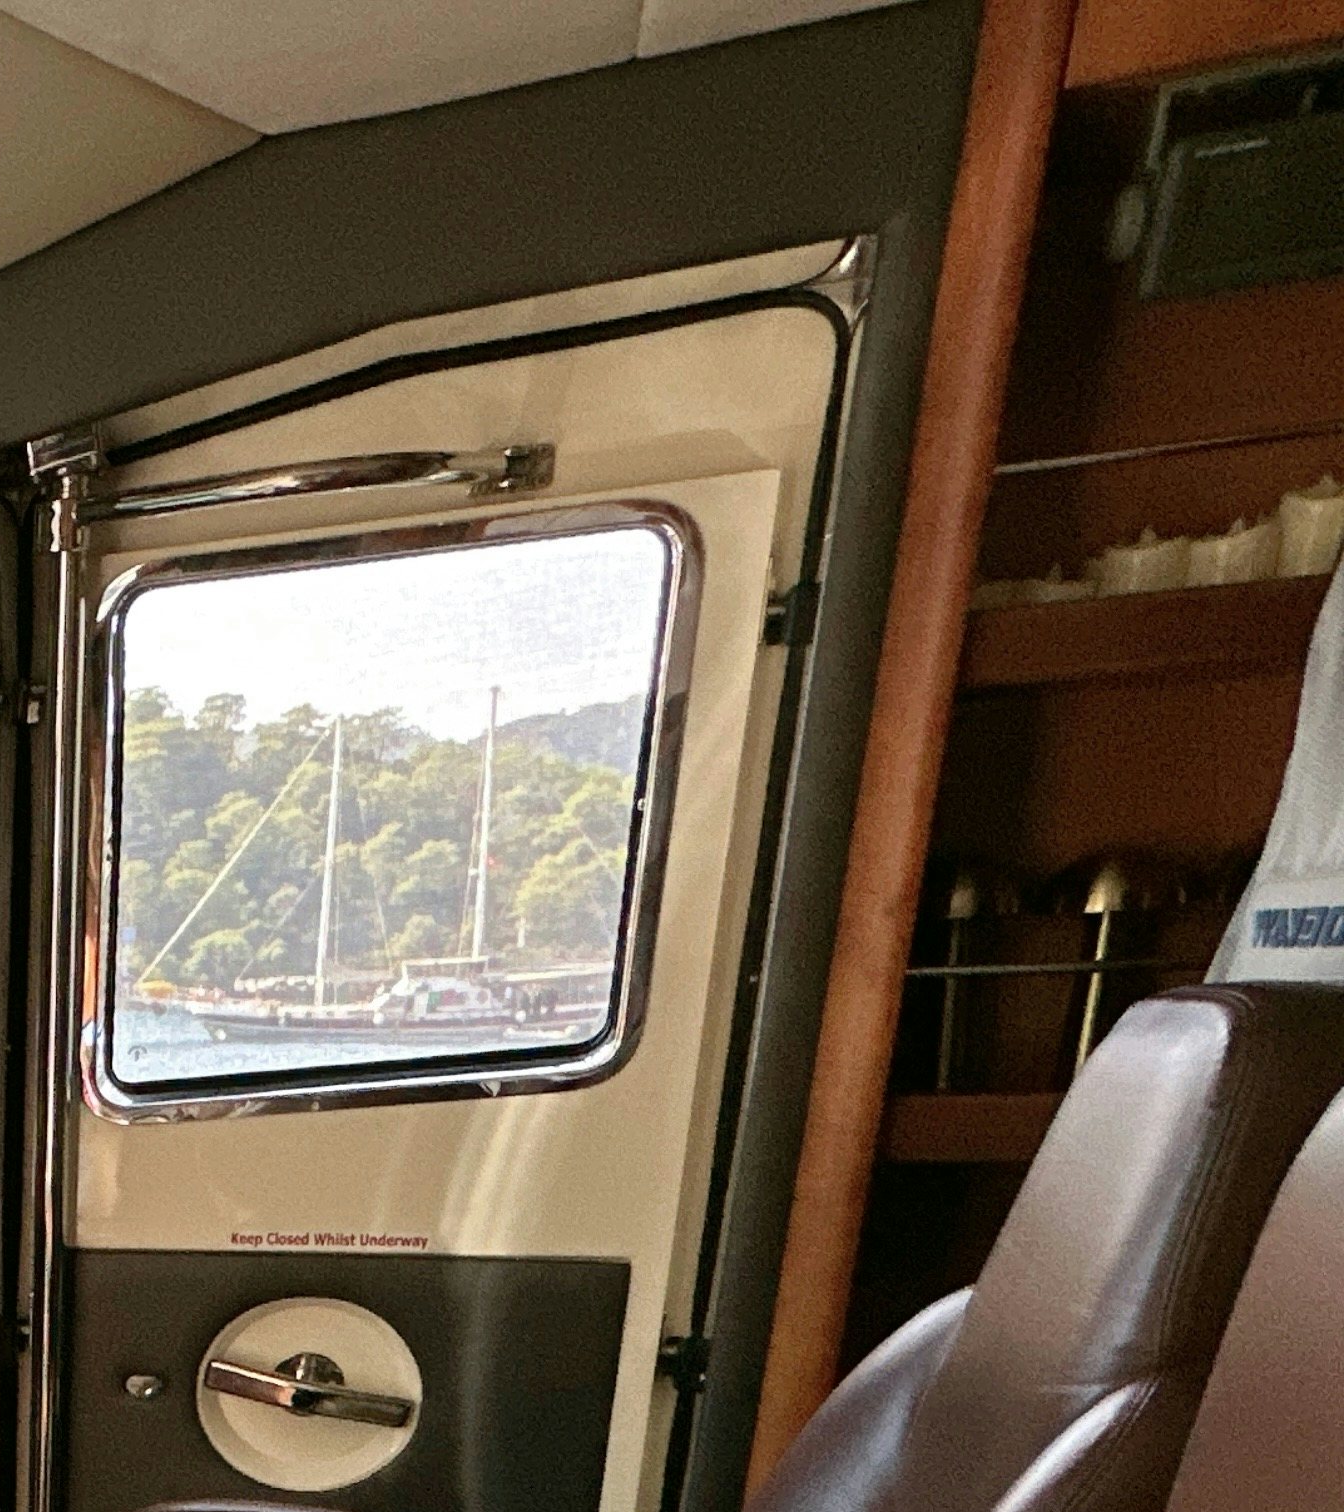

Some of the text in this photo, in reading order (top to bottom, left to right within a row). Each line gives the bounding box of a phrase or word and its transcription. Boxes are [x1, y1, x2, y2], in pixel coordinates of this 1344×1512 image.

[231, 1231, 429, 1250] Keep Closed Whilst Underway
